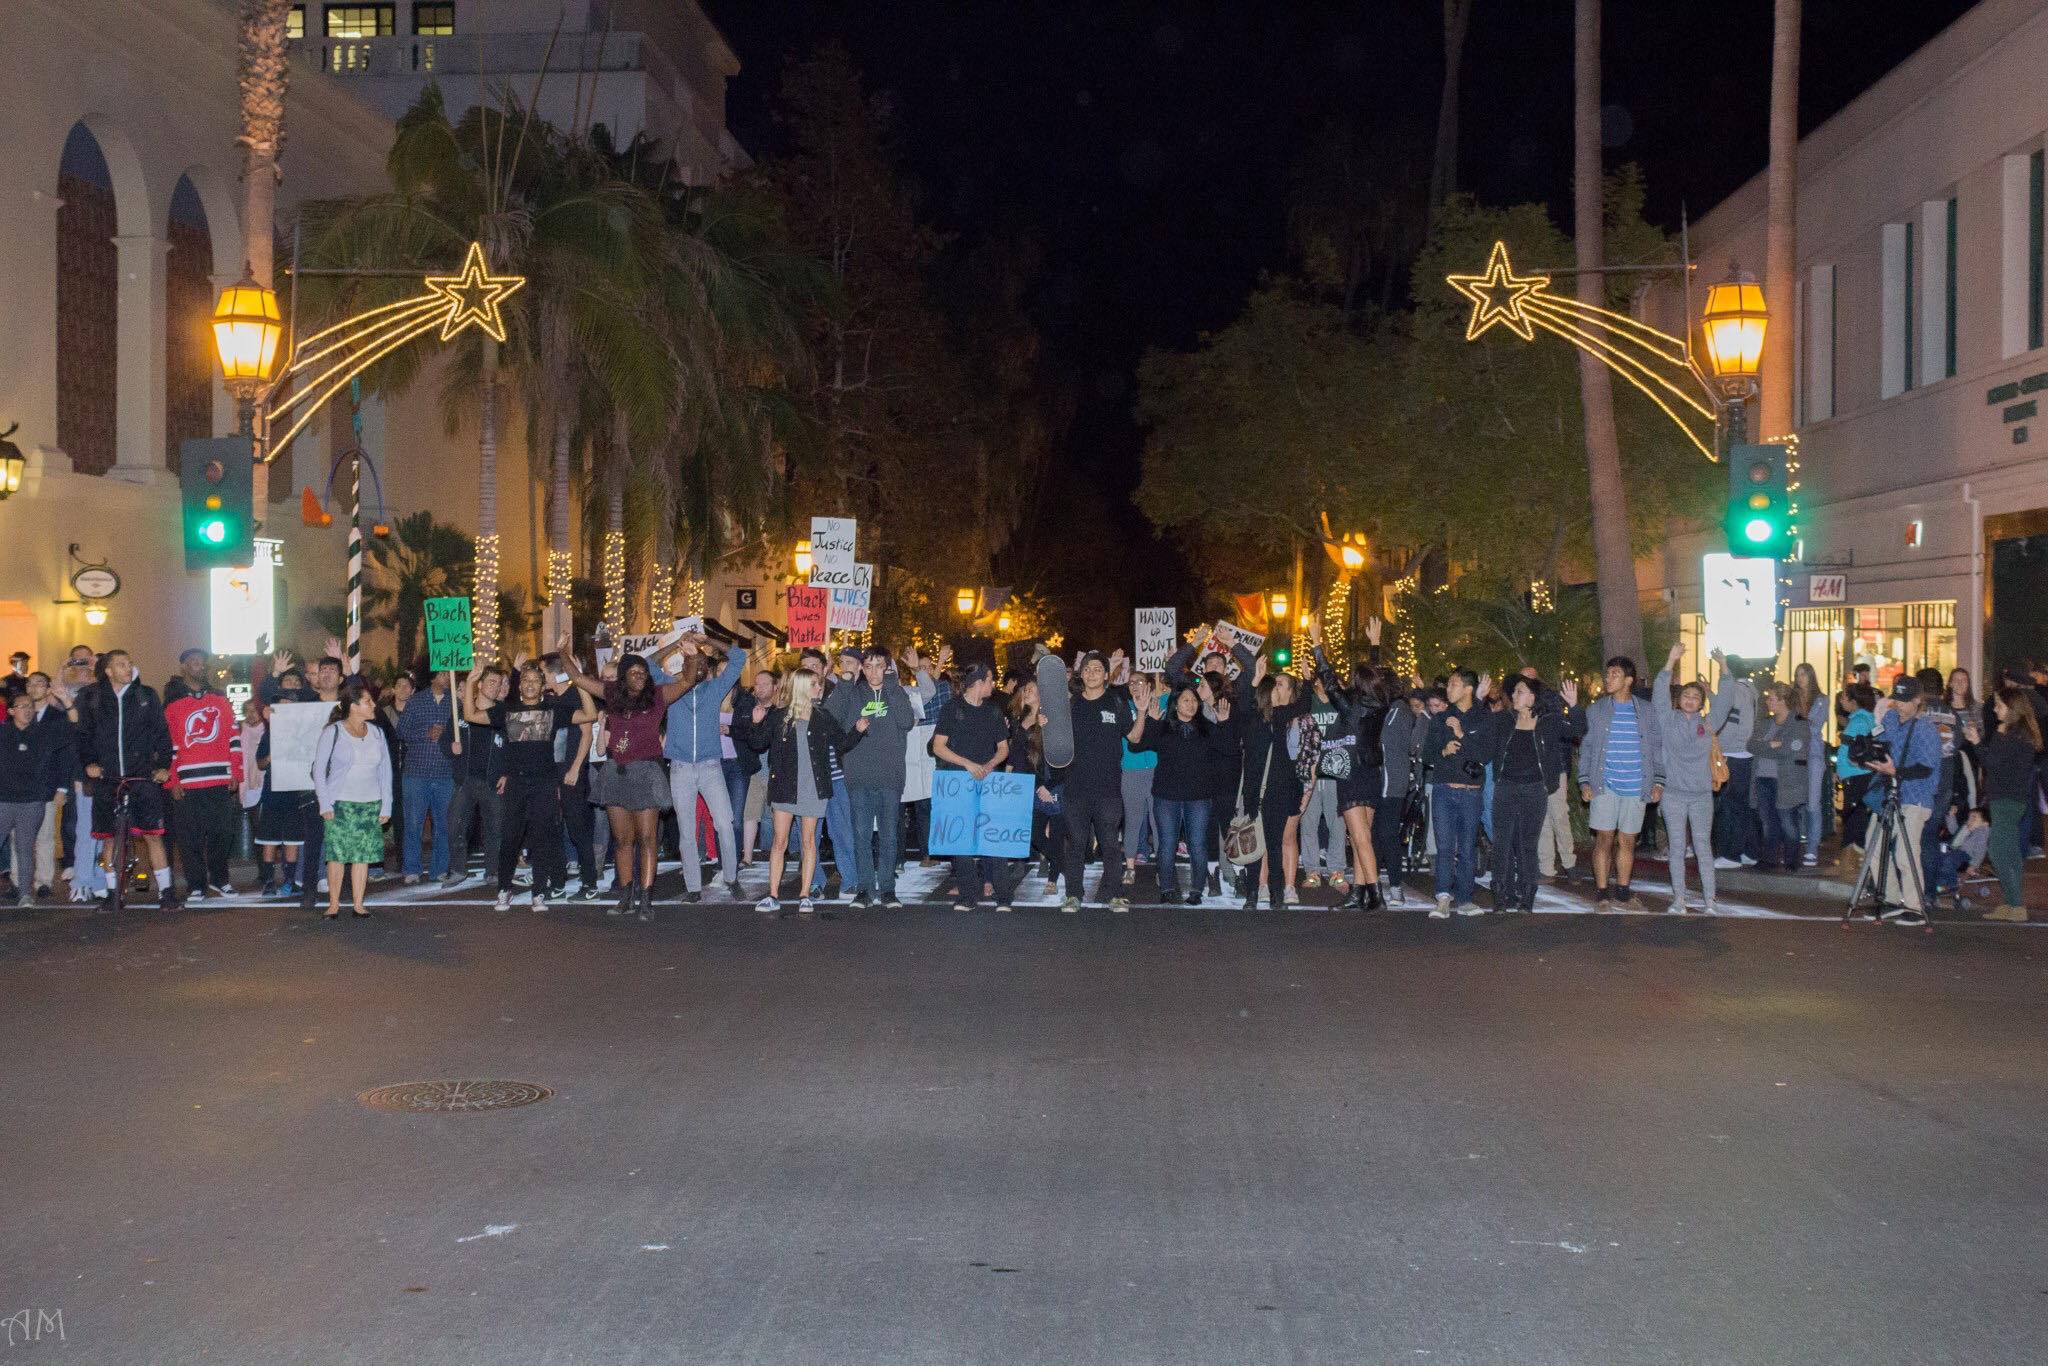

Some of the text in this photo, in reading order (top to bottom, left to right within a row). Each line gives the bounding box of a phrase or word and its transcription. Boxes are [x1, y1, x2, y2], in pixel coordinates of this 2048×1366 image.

[826, 520, 841, 532] NO
[812, 531, 854, 552] Justice
[824, 554, 839, 565] NO
[810, 564, 851, 585] Peace
[741, 592, 753, 604] G
[787, 586, 827, 609] Black
[426, 600, 467, 622] Black
[1139, 609, 1175, 628] HANDS
[431, 625, 470, 646] Lives
[789, 626, 826, 644] Matter
[431, 648, 473, 668] Matter
[1139, 656, 1167, 671] SHOO
[936, 775, 1022, 798] NO Justice
[931, 813, 1030, 848] NO Peace
